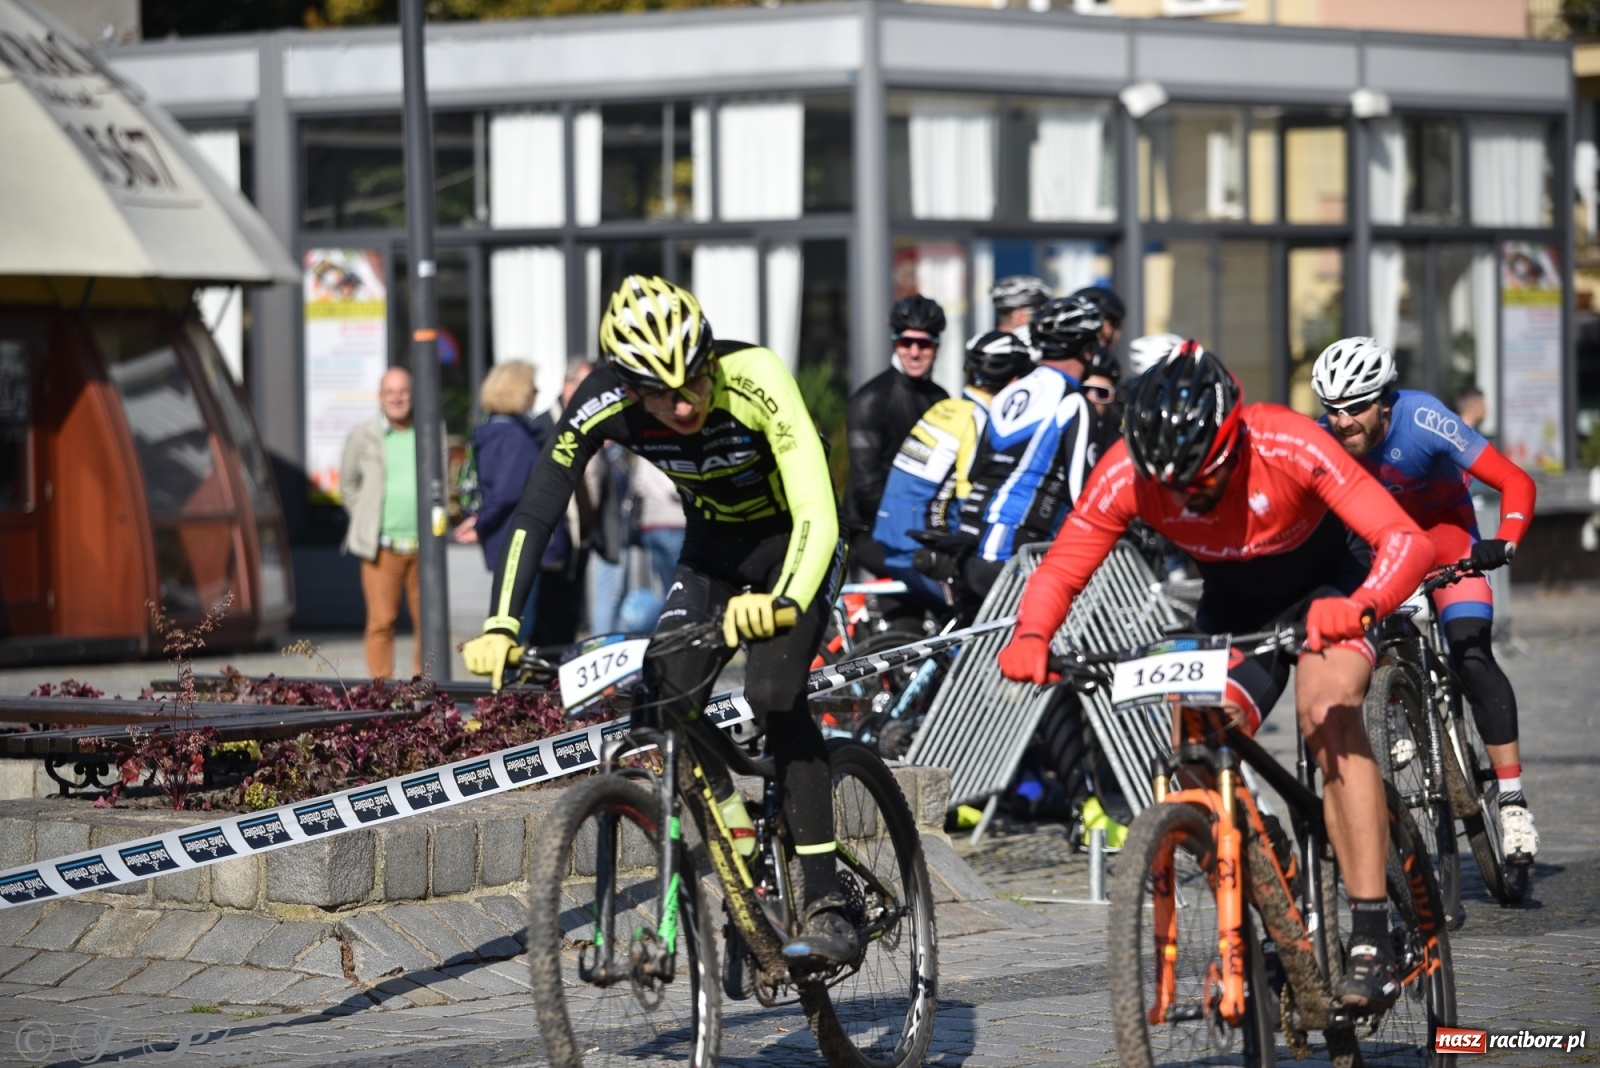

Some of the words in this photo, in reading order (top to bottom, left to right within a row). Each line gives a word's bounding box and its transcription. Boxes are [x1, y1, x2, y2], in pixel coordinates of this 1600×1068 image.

[731, 376, 779, 415] HEAD
[1414, 406, 1459, 438] CRYO
[576, 648, 629, 689] 3176
[1133, 660, 1204, 688] 1628
